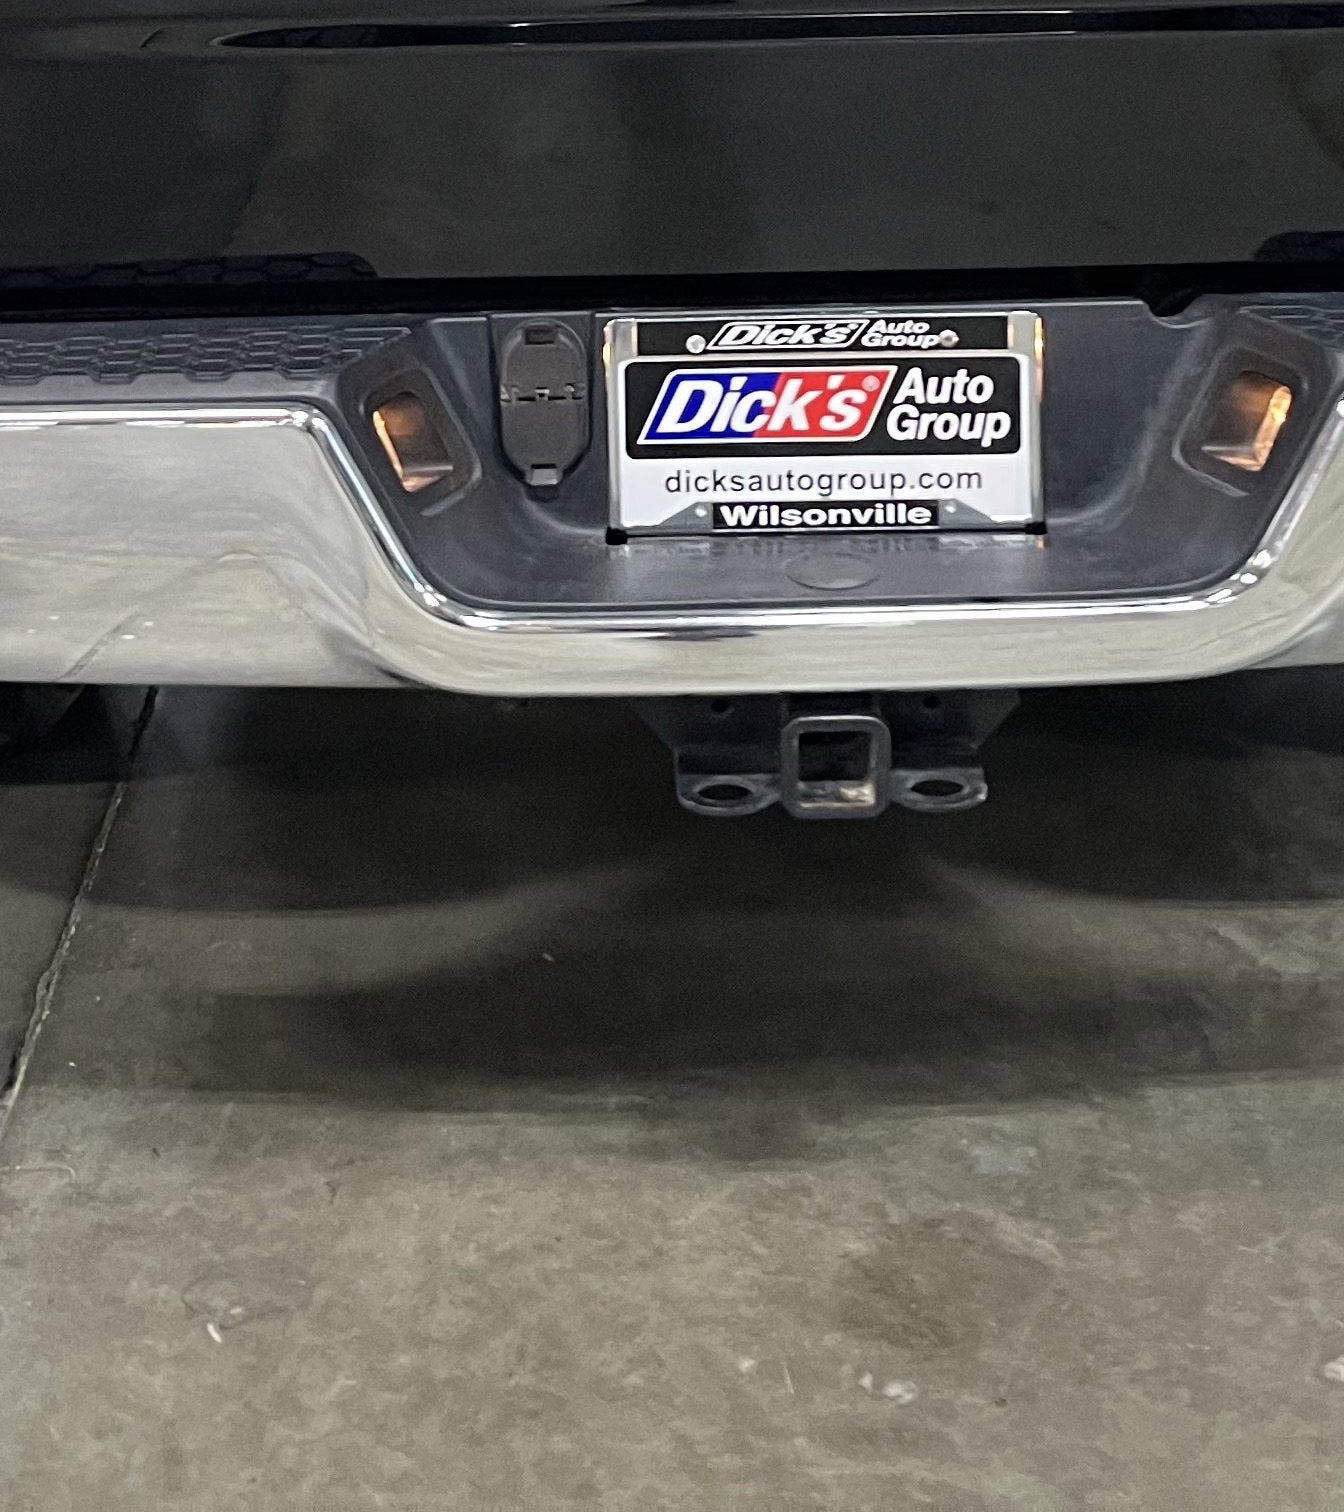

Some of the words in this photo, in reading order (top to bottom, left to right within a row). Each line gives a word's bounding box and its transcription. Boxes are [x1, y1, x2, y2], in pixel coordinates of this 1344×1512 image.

[868, 319, 930, 334] Auto
[861, 333, 940, 349] Group
[890, 367, 994, 405] Auto
[886, 406, 1011, 447] Group
[665, 468, 983, 496] dicksautogroup.com
[719, 504, 933, 527] Wilsonville
